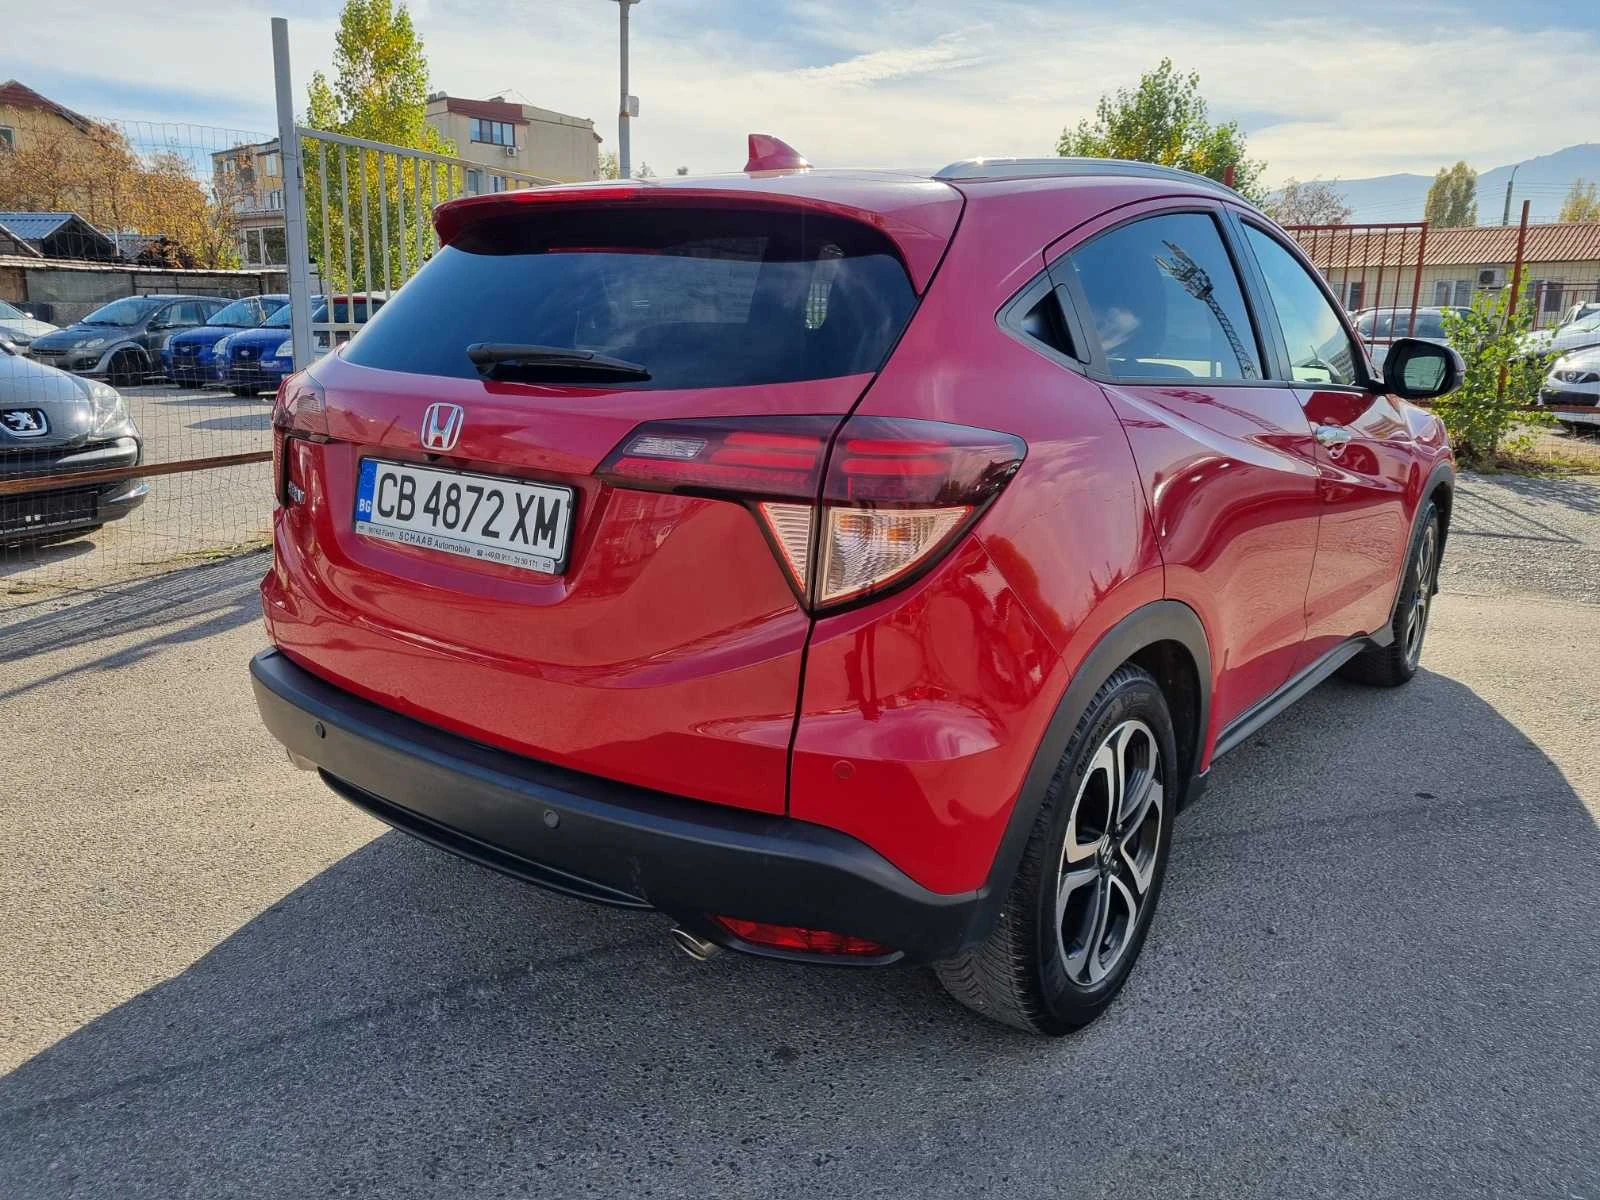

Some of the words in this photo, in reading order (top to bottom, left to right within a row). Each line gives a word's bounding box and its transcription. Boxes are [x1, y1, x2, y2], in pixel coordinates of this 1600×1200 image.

[358, 498, 372, 513] BG
[377, 472, 417, 522] CB
[423, 480, 505, 539] 4872
[509, 492, 561, 550] XM
[398, 531, 433, 546] SCHAAB
[433, 540, 471, 555] Automobile
